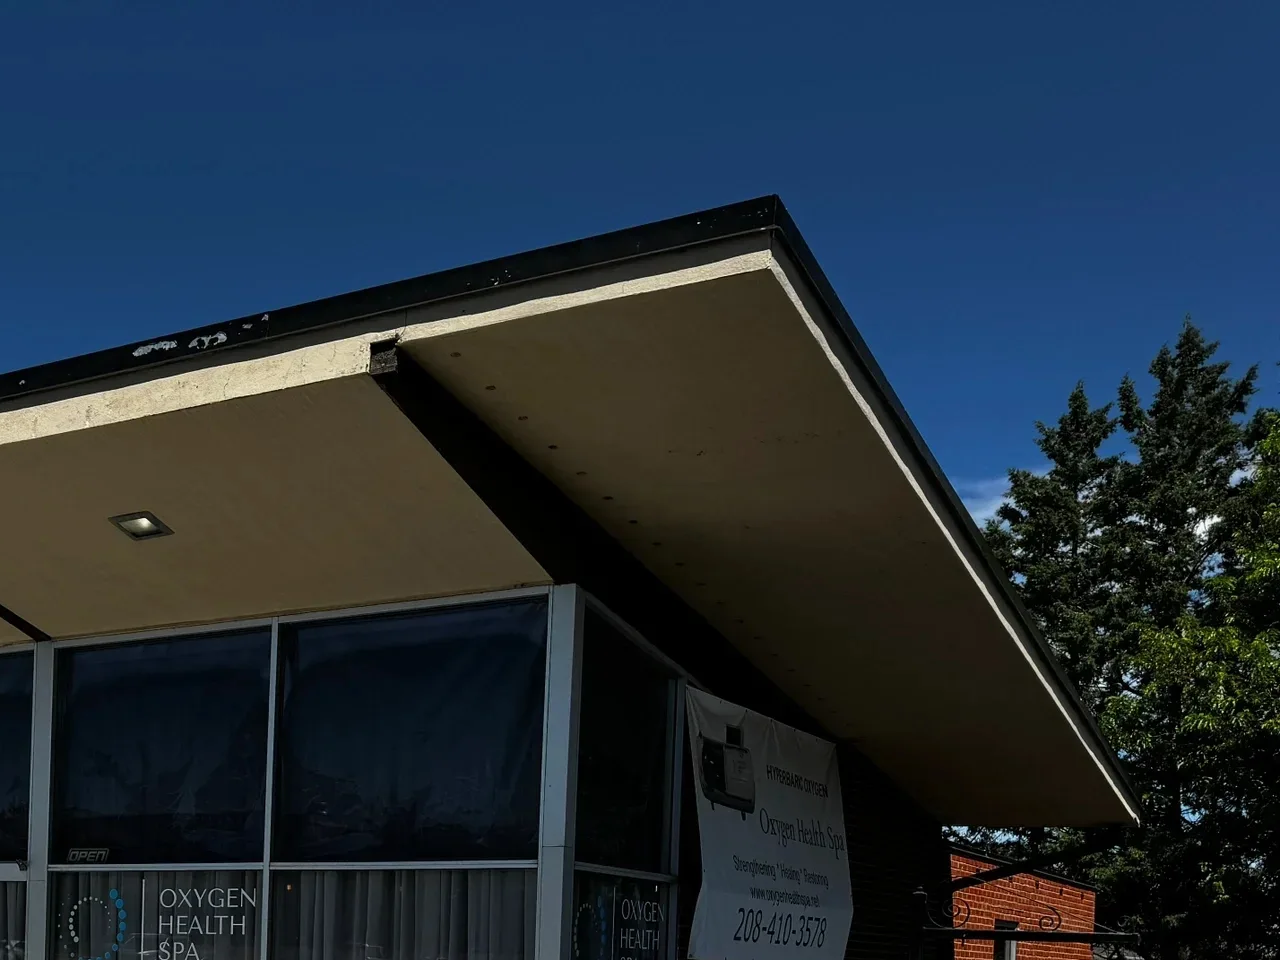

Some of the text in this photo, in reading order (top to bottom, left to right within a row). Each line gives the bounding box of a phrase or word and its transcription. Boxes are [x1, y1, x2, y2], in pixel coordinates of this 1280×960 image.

[766, 764, 829, 798] HYPERBARIC OXYGEN
[759, 807, 845, 859] Oxygen Health Spa
[68, 850, 106, 862] OPEN
[732, 855, 829, 890] Strengthening Healing Restoring
[159, 887, 256, 908] OXYGEN
[621, 898, 664, 922] OXYGEN
[158, 915, 246, 935] HEALTH
[733, 907, 827, 948] 208-410-3578
[620, 927, 660, 951] HEALTH
